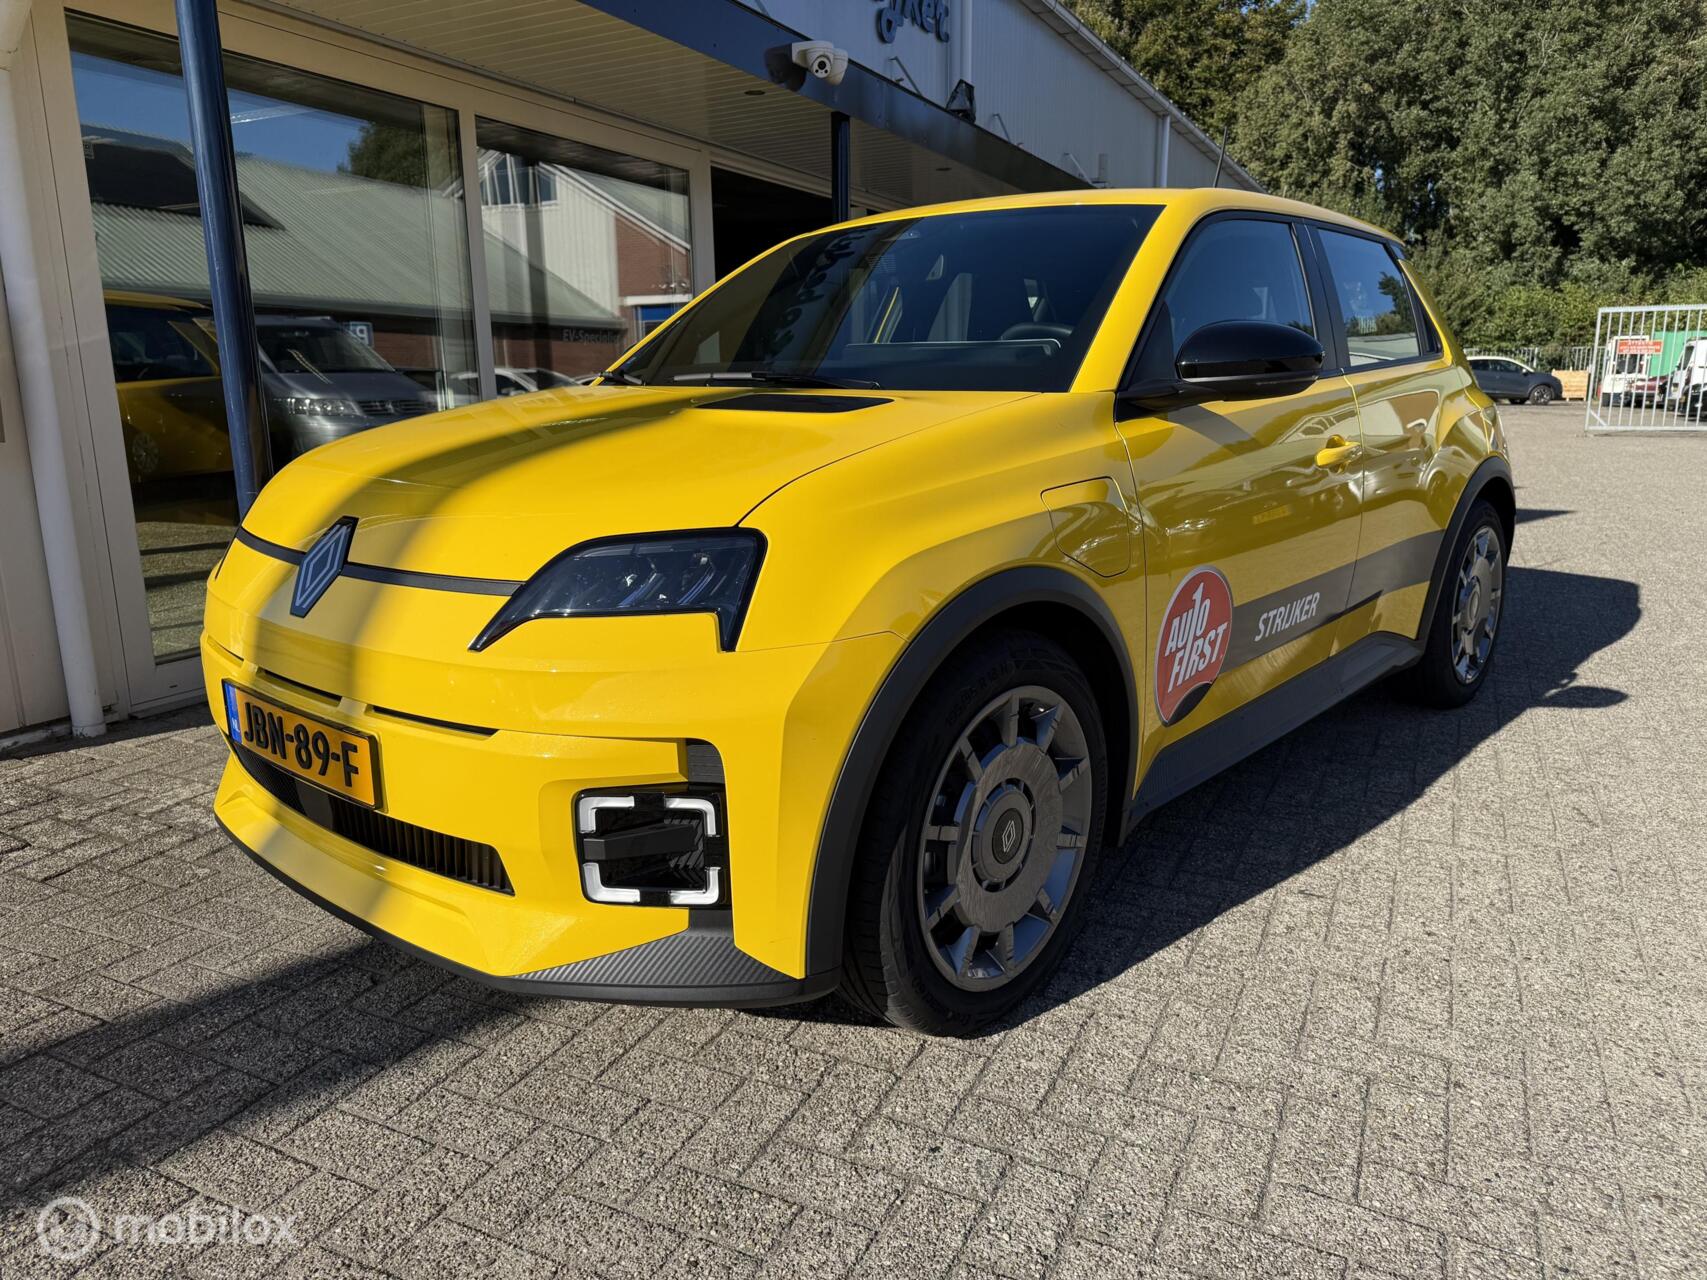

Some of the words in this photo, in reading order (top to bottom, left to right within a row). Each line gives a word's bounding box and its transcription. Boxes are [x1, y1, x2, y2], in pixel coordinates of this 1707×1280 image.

[1254, 592, 1320, 642] STRIJKER
[1168, 621, 1229, 694] FIRST
[243, 701, 359, 788] JBN-89-F
